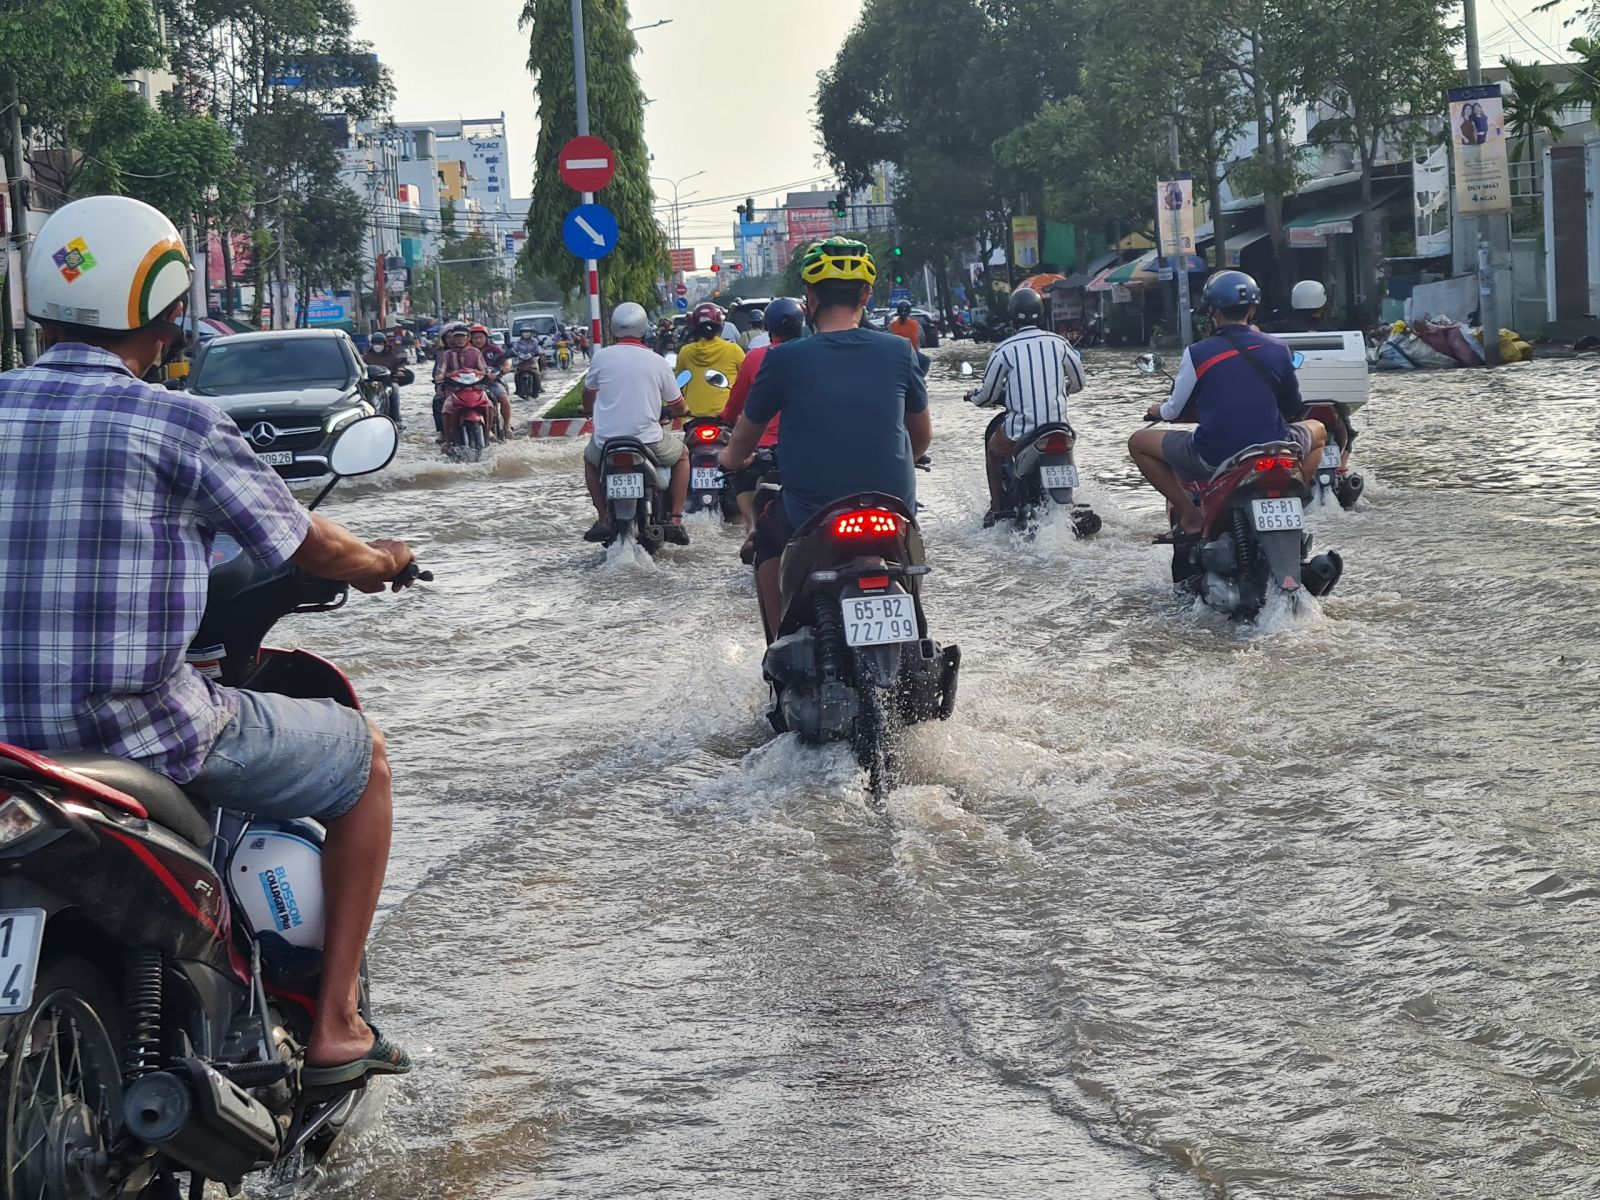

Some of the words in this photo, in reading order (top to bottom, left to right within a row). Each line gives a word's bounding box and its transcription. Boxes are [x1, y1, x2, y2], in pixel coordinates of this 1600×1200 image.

[1046, 466, 1072, 476] 65-F5
[613, 475, 637, 486] 65-B1
[1260, 500, 1294, 514] 65-B1
[1258, 514, 1302, 529] 865.63
[854, 599, 903, 620] 65-B2
[850, 619, 913, 642] 727.99
[194, 879, 214, 897] Fi
[265, 869, 288, 914] COLLAGEN
[274, 866, 303, 927] BLOSSOM
